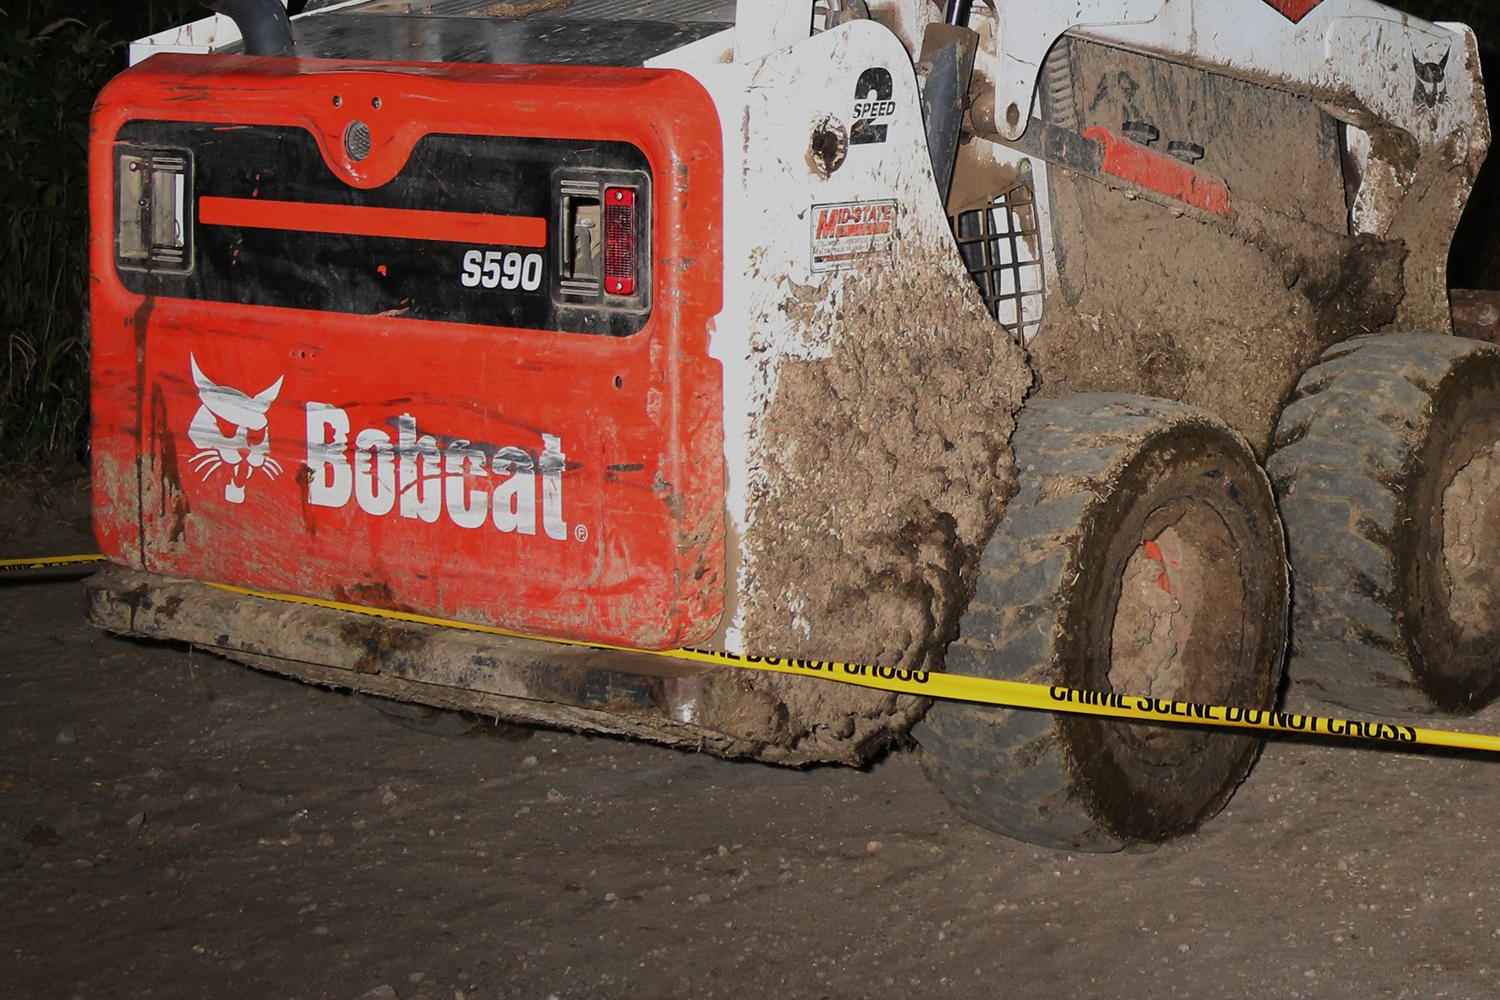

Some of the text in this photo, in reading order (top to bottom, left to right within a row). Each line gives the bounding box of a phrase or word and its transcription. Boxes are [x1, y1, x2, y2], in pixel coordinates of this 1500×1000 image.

[850, 66, 893, 146] 2
[852, 101, 896, 120] SPEED
[461, 250, 543, 292] S590
[305, 401, 568, 541] Bobcat
